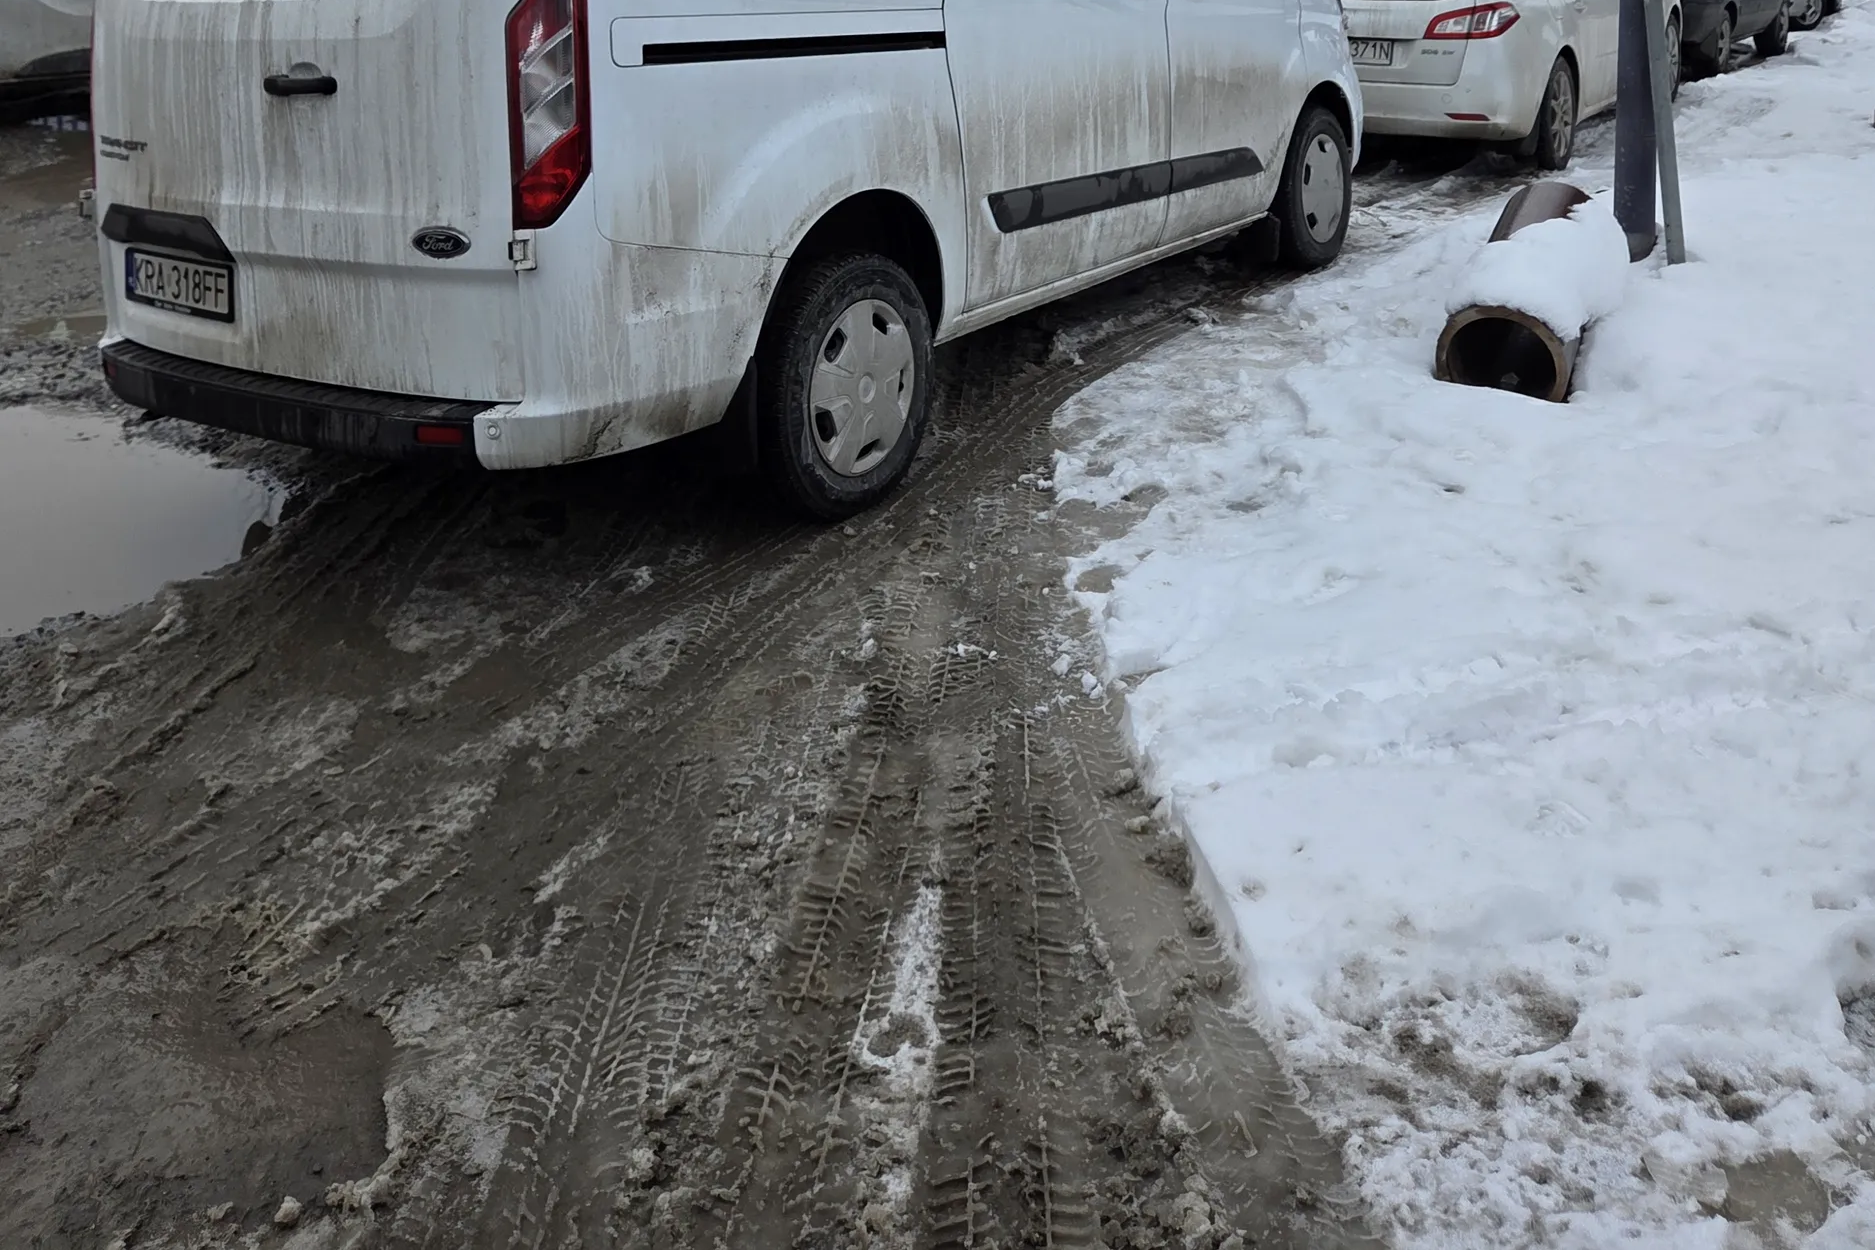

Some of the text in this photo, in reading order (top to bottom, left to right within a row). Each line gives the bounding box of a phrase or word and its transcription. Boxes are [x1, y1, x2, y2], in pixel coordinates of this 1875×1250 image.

[1350, 40, 1389, 60] 371N
[422, 234, 454, 250] Ford
[134, 256, 226, 309] KRA 318FF
